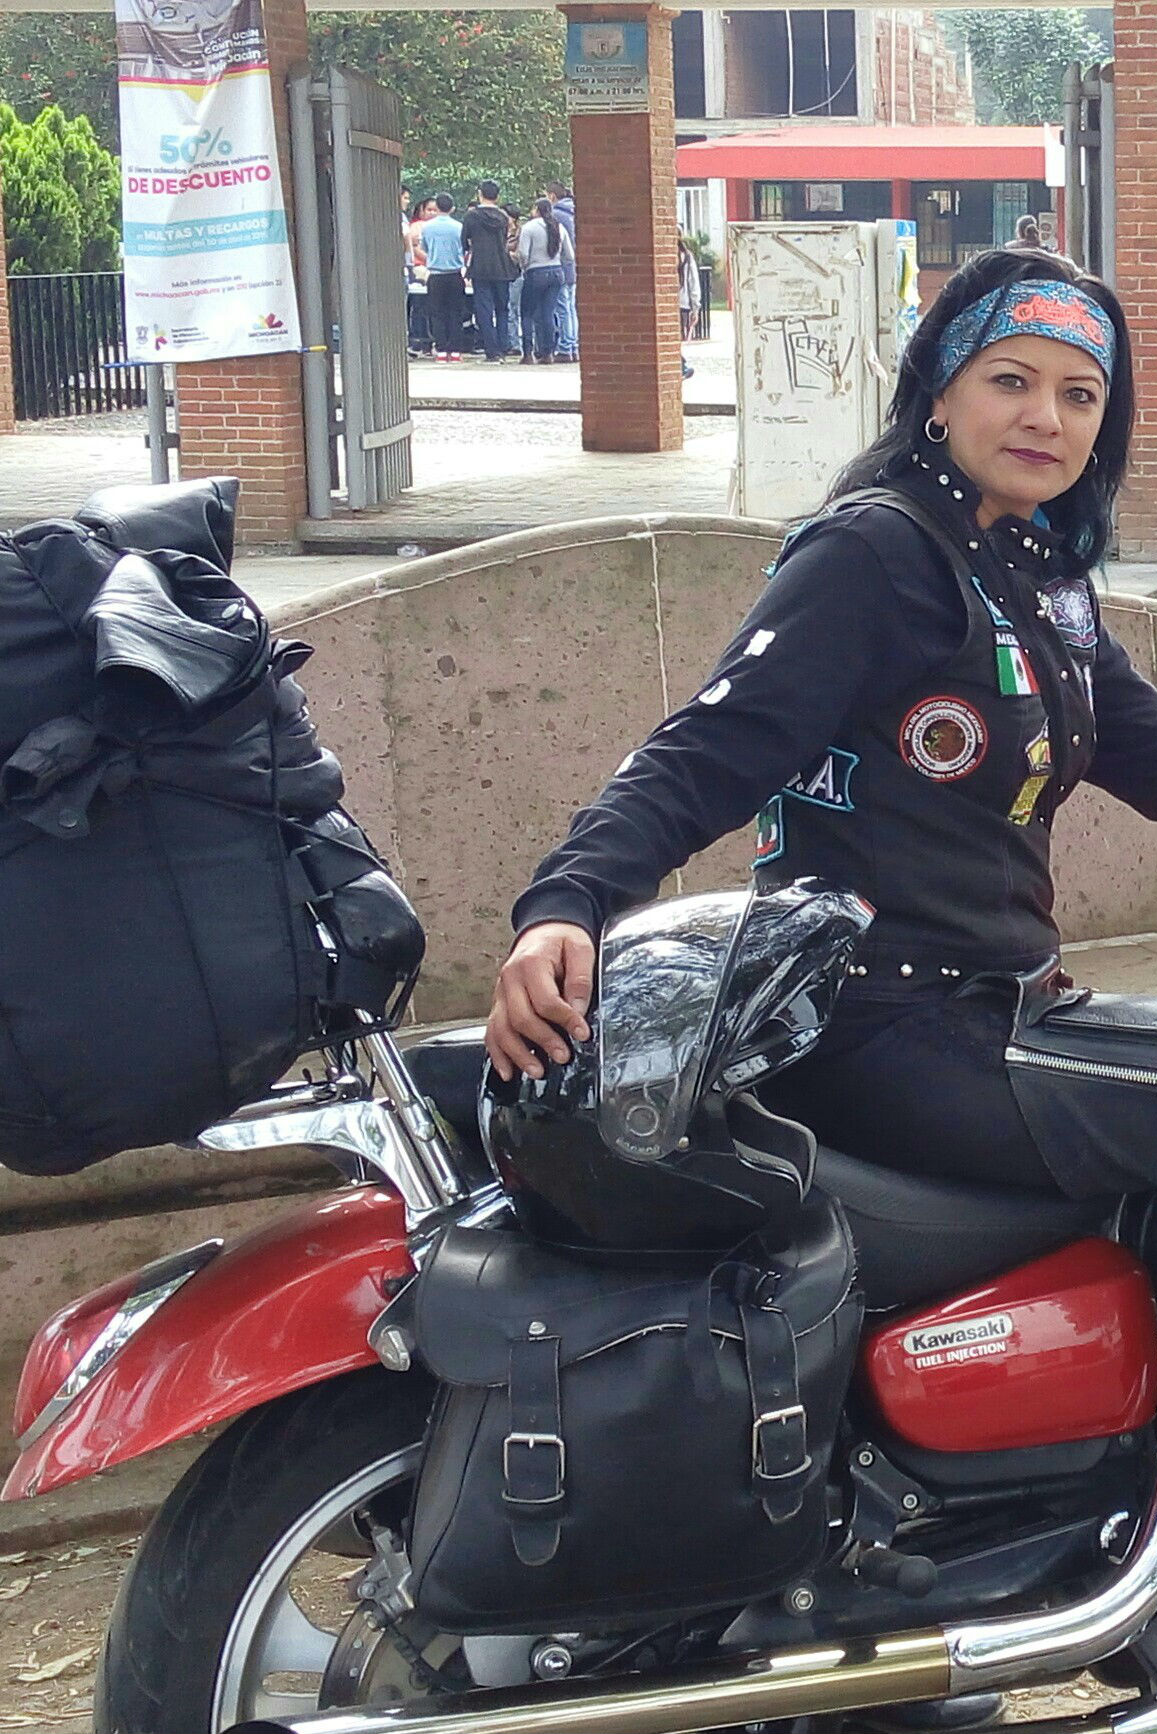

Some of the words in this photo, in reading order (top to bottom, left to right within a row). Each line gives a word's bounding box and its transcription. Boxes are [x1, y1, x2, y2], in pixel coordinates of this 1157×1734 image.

[159, 127, 232, 164] 50%
[128, 177, 149, 193] DE
[152, 164, 271, 195] DESCUENTO
[911, 1318, 1006, 1351] Kawasaki
[915, 1353, 944, 1369] FUEL
[946, 1341, 1006, 1362] INJECTION
